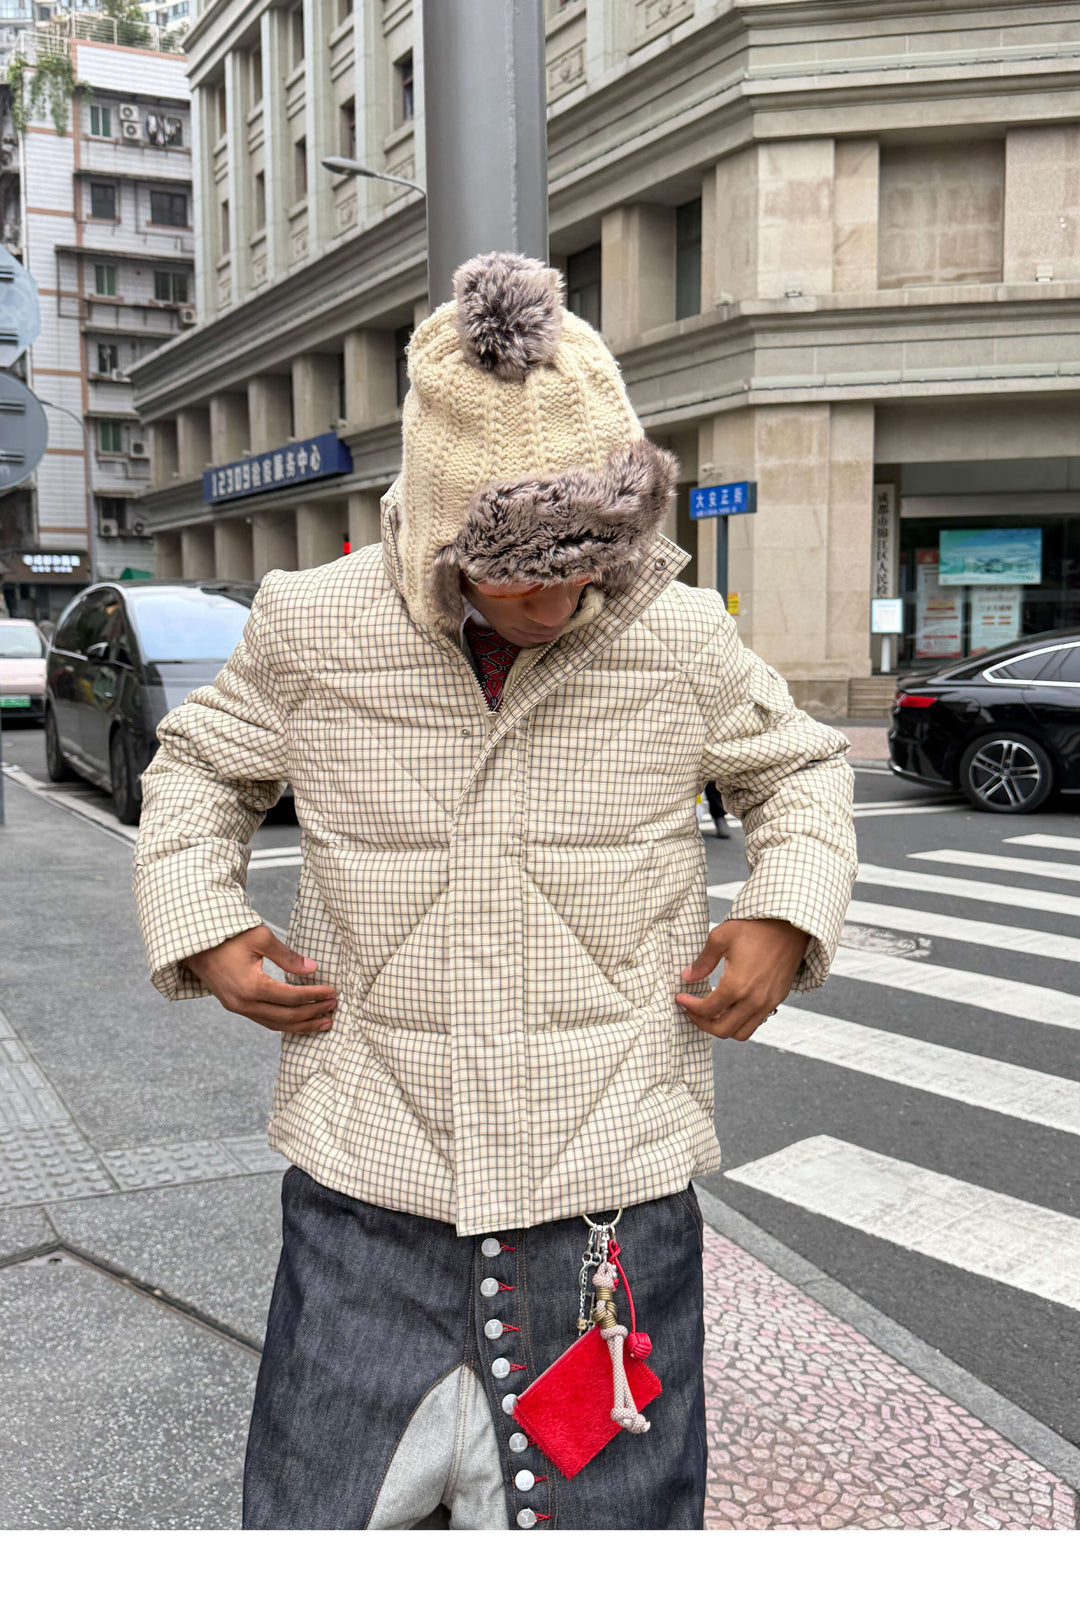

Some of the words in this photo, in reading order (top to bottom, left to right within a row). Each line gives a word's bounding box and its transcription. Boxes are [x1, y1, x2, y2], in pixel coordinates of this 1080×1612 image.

[695, 487, 743, 509] 大安正街
[876, 492, 889, 599] 成都市锦江区人民检
